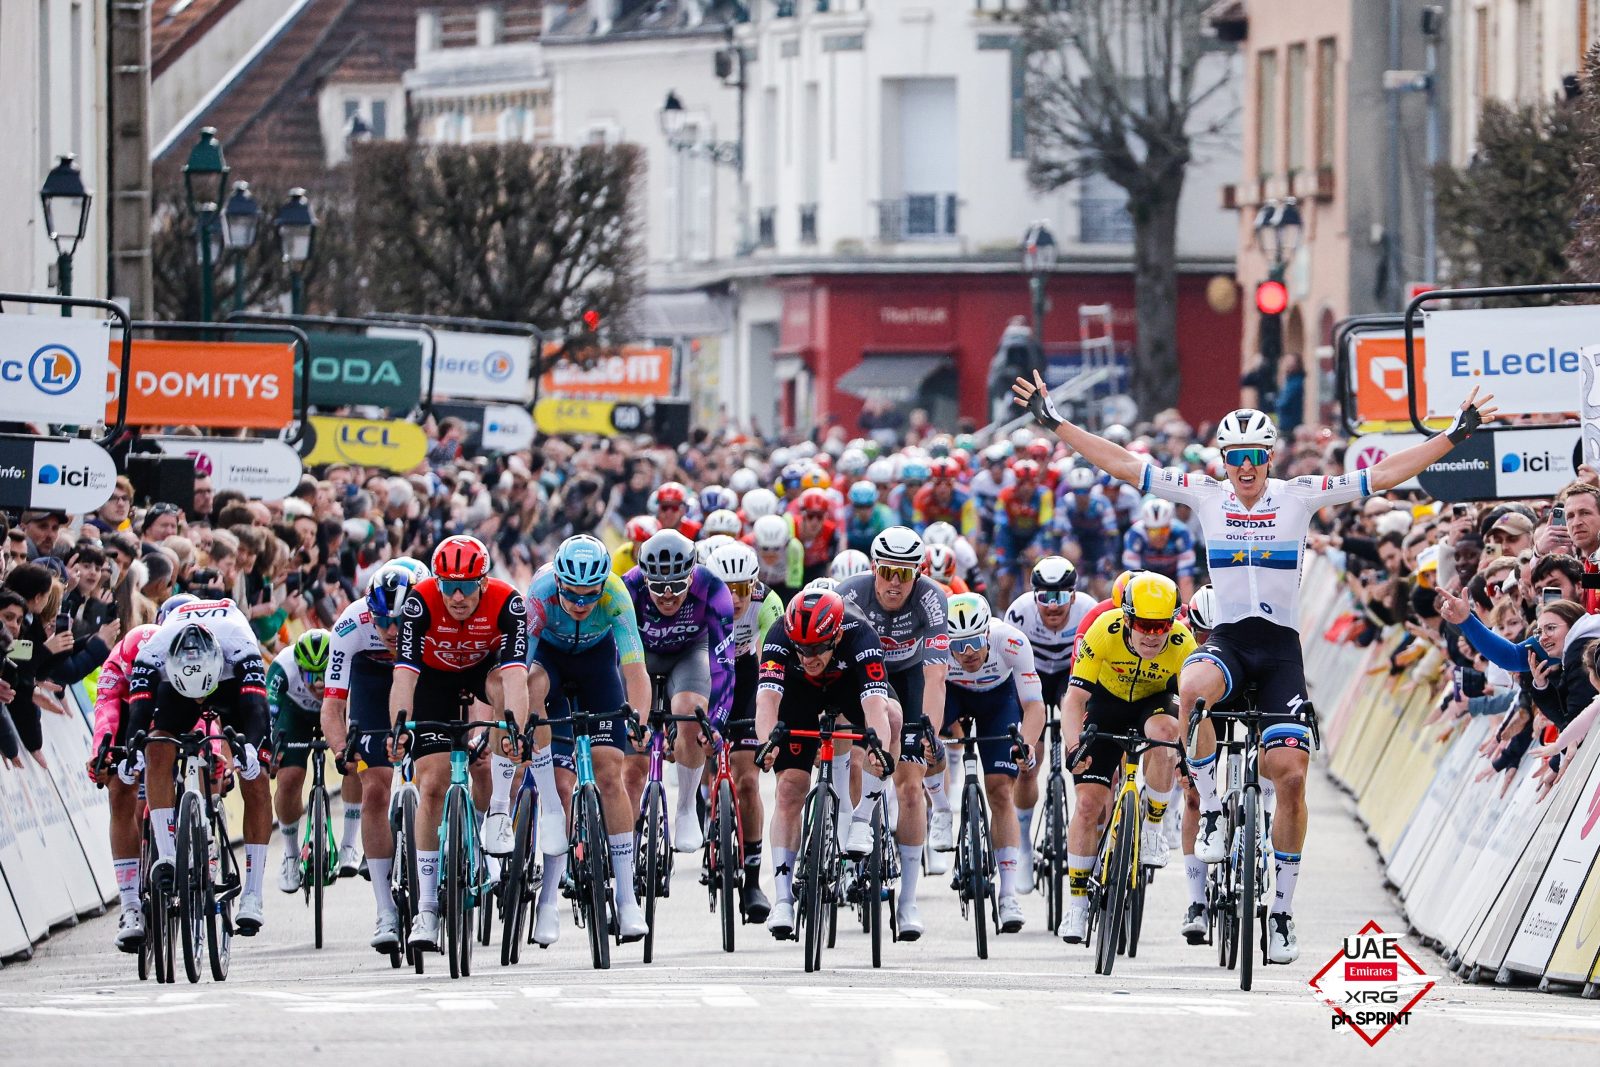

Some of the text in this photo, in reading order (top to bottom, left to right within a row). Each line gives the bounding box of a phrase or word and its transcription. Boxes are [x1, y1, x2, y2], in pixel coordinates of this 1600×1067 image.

[135, 370, 280, 400] DOMITYS
[341, 424, 400, 448] LCL
[1522, 451, 1550, 472] ici
[60, 464, 90, 488] ici
[1226, 519, 1276, 529] SOUDAL
[923, 588, 946, 626] Alpecin
[334, 617, 355, 633] BORA
[638, 621, 700, 638] Jayco
[401, 620, 414, 661] ARKEA
[513, 618, 527, 658] ARKEA
[182, 664, 202, 677] G42
[330, 650, 346, 681] BOSS
[599, 720, 613, 729] 83
